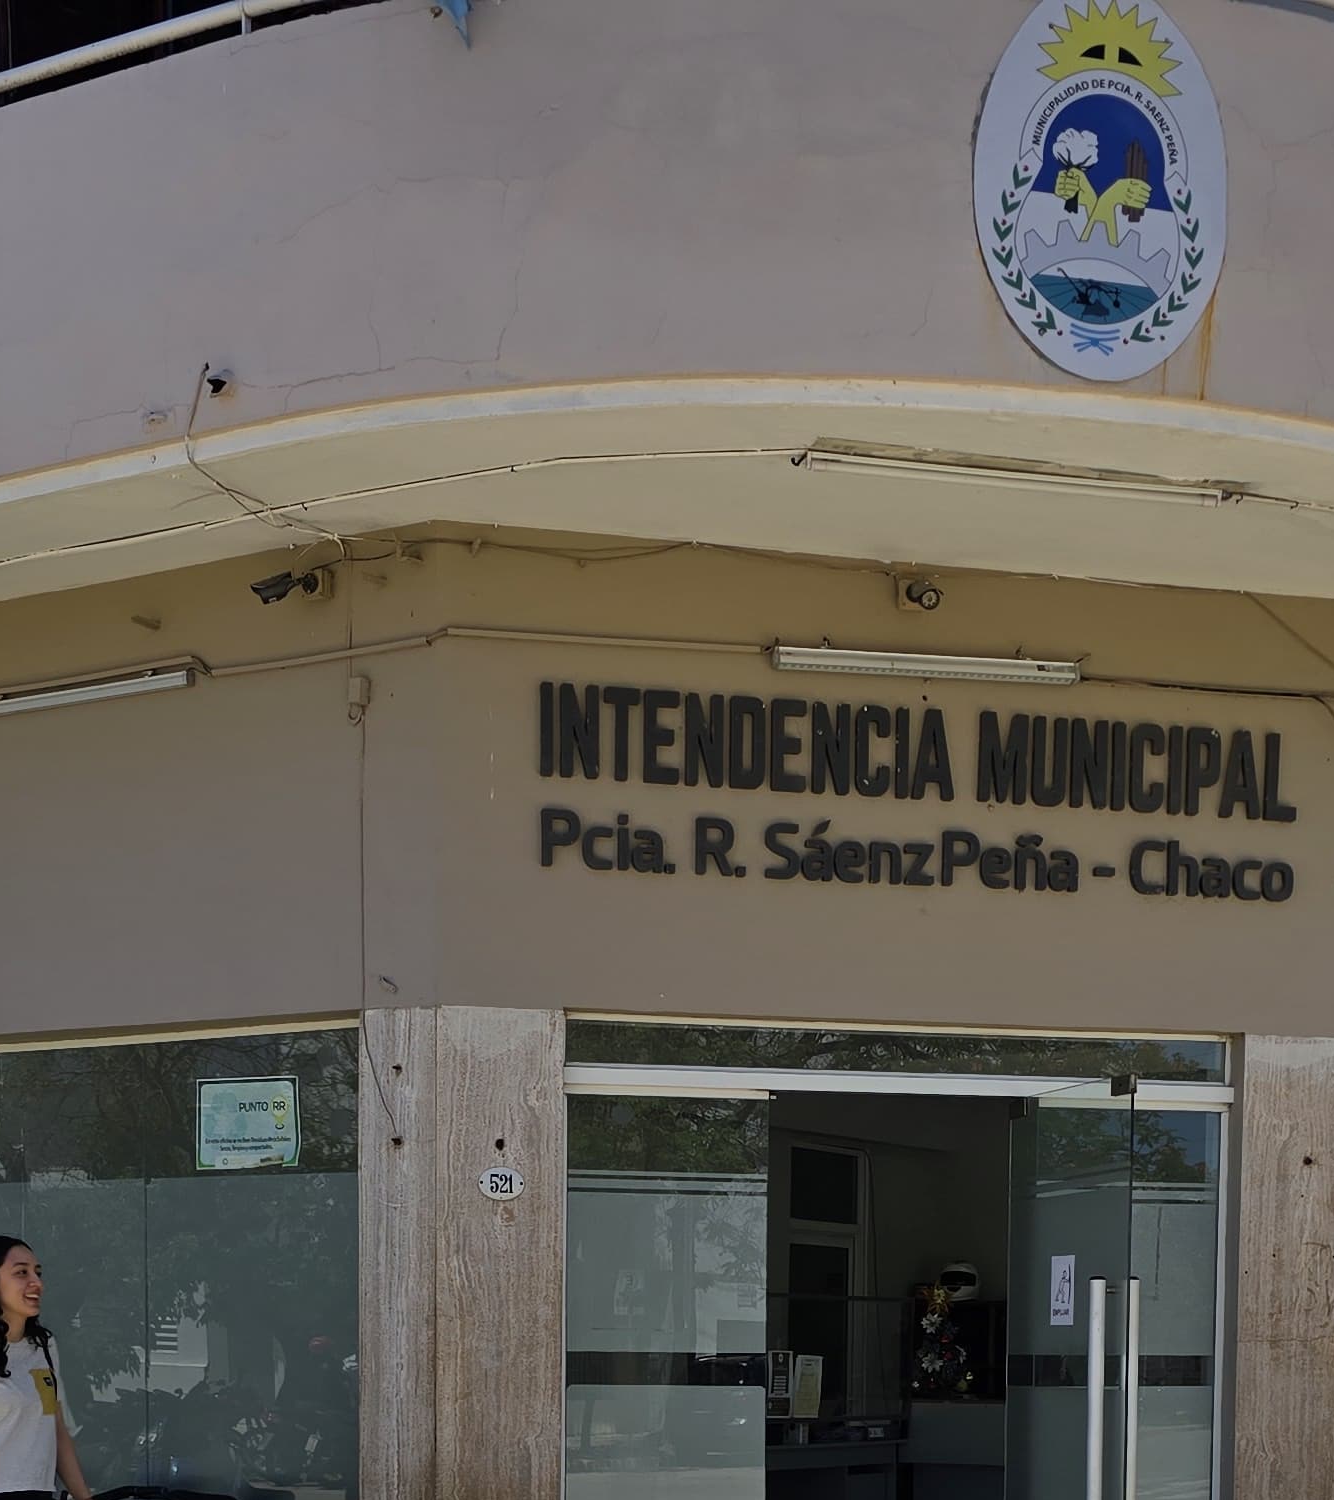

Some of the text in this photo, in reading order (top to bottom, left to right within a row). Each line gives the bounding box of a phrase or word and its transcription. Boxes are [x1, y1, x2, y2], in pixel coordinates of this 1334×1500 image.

[1032, 79, 1179, 165] MUNICIPALIDAD DE PCIA. R. SAENZ PEÑA
[539, 681, 954, 802] INTENDENCIA
[976, 710, 1297, 823] MUNICIPAL
[540, 808, 675, 875] Pcia.
[694, 817, 746, 878] R.
[764, 819, 934, 887] Sáenz
[941, 830, 1079, 893] Peña
[1128, 839, 1294, 903] Chaco
[239, 1101, 286, 1113] PUNTO RR
[490, 1174, 514, 1193] 521
